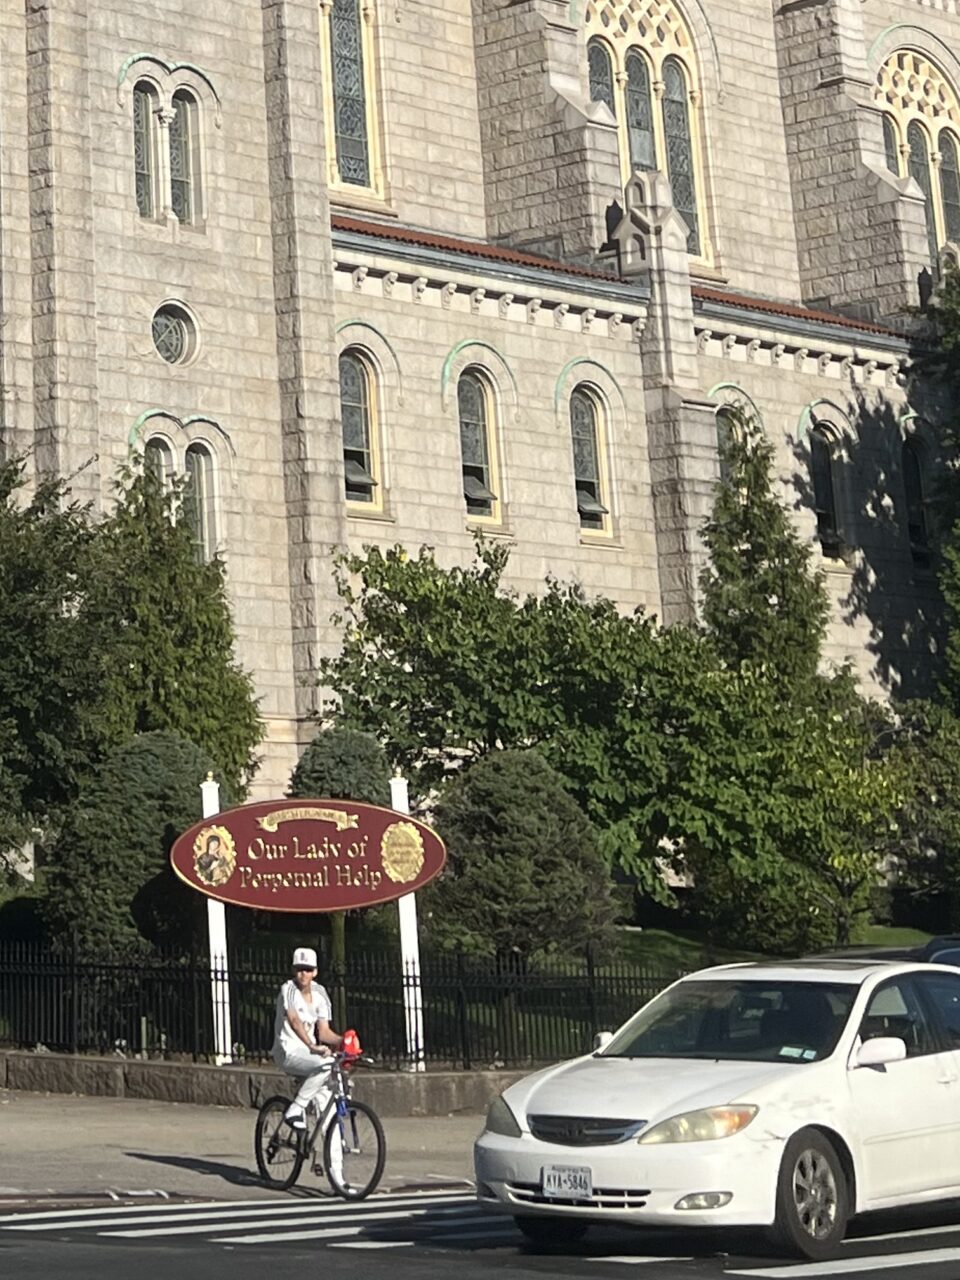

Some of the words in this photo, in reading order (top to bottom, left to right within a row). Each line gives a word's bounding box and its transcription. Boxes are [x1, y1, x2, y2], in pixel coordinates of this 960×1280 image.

[247, 837, 288, 860] Our
[292, 836, 342, 861] Lady
[347, 835, 369, 858] of
[239, 865, 330, 893] Perpetual
[335, 864, 382, 891] Help
